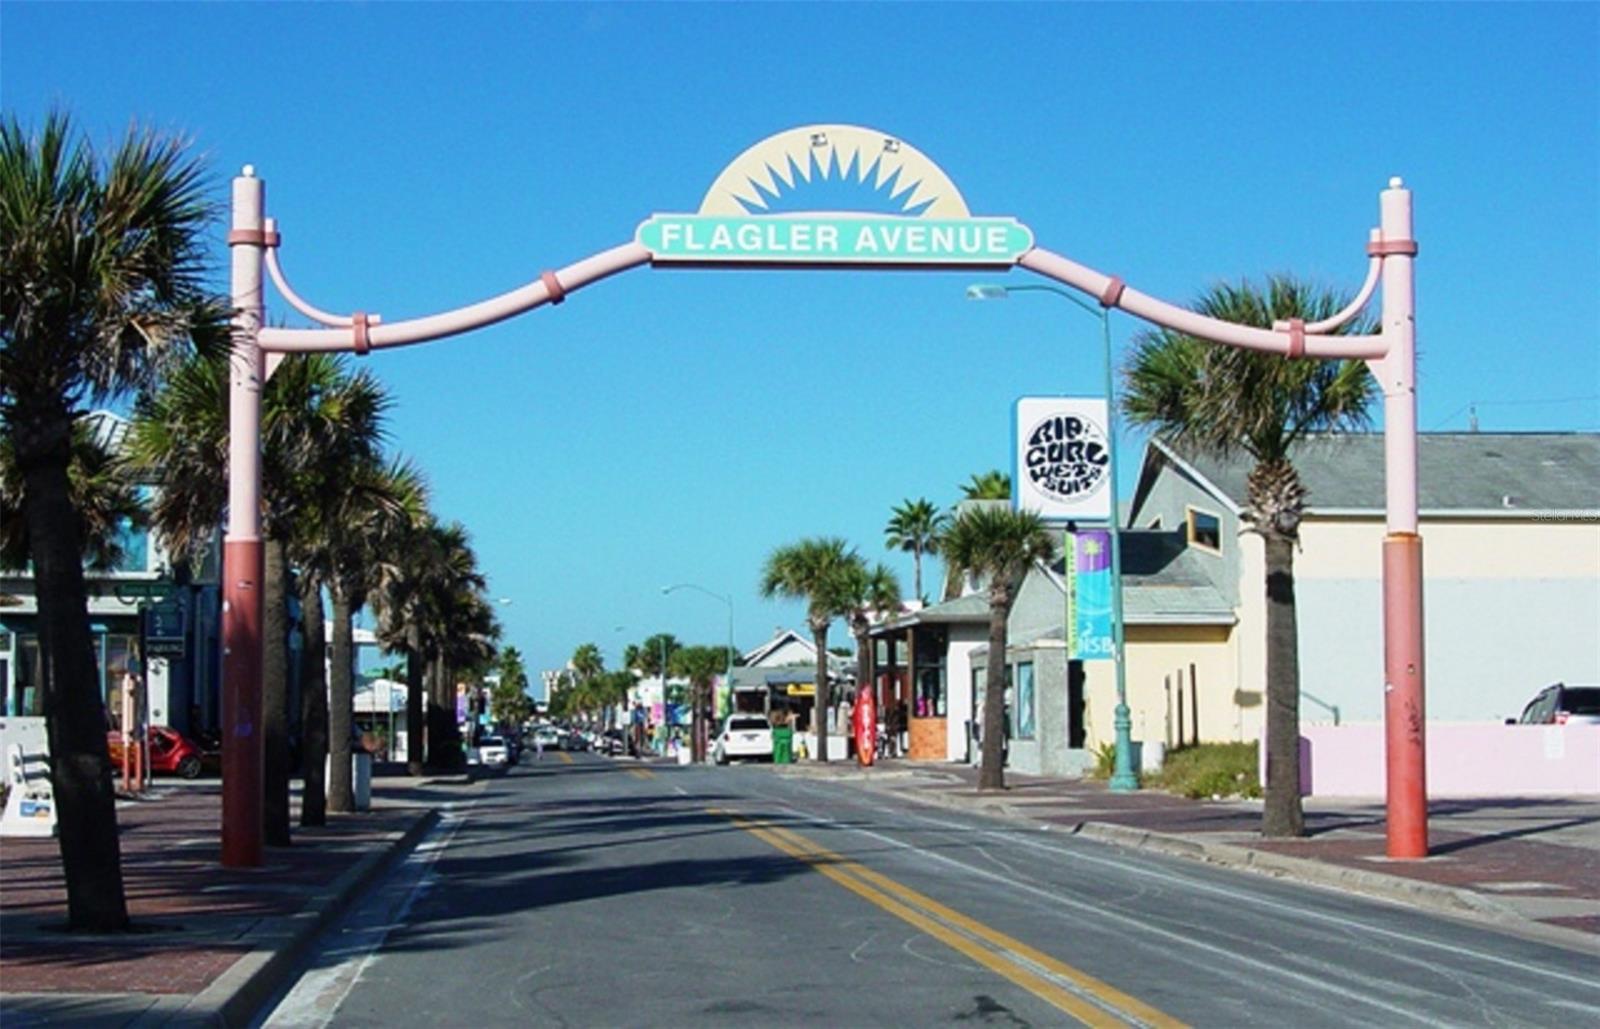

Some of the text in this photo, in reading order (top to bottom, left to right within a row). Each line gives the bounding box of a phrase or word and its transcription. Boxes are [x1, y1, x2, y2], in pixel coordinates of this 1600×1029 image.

[661, 224, 1009, 254] FLAGLER AVENUE
[1028, 416, 1083, 445] RIP
[1026, 441, 1109, 468] CURL
